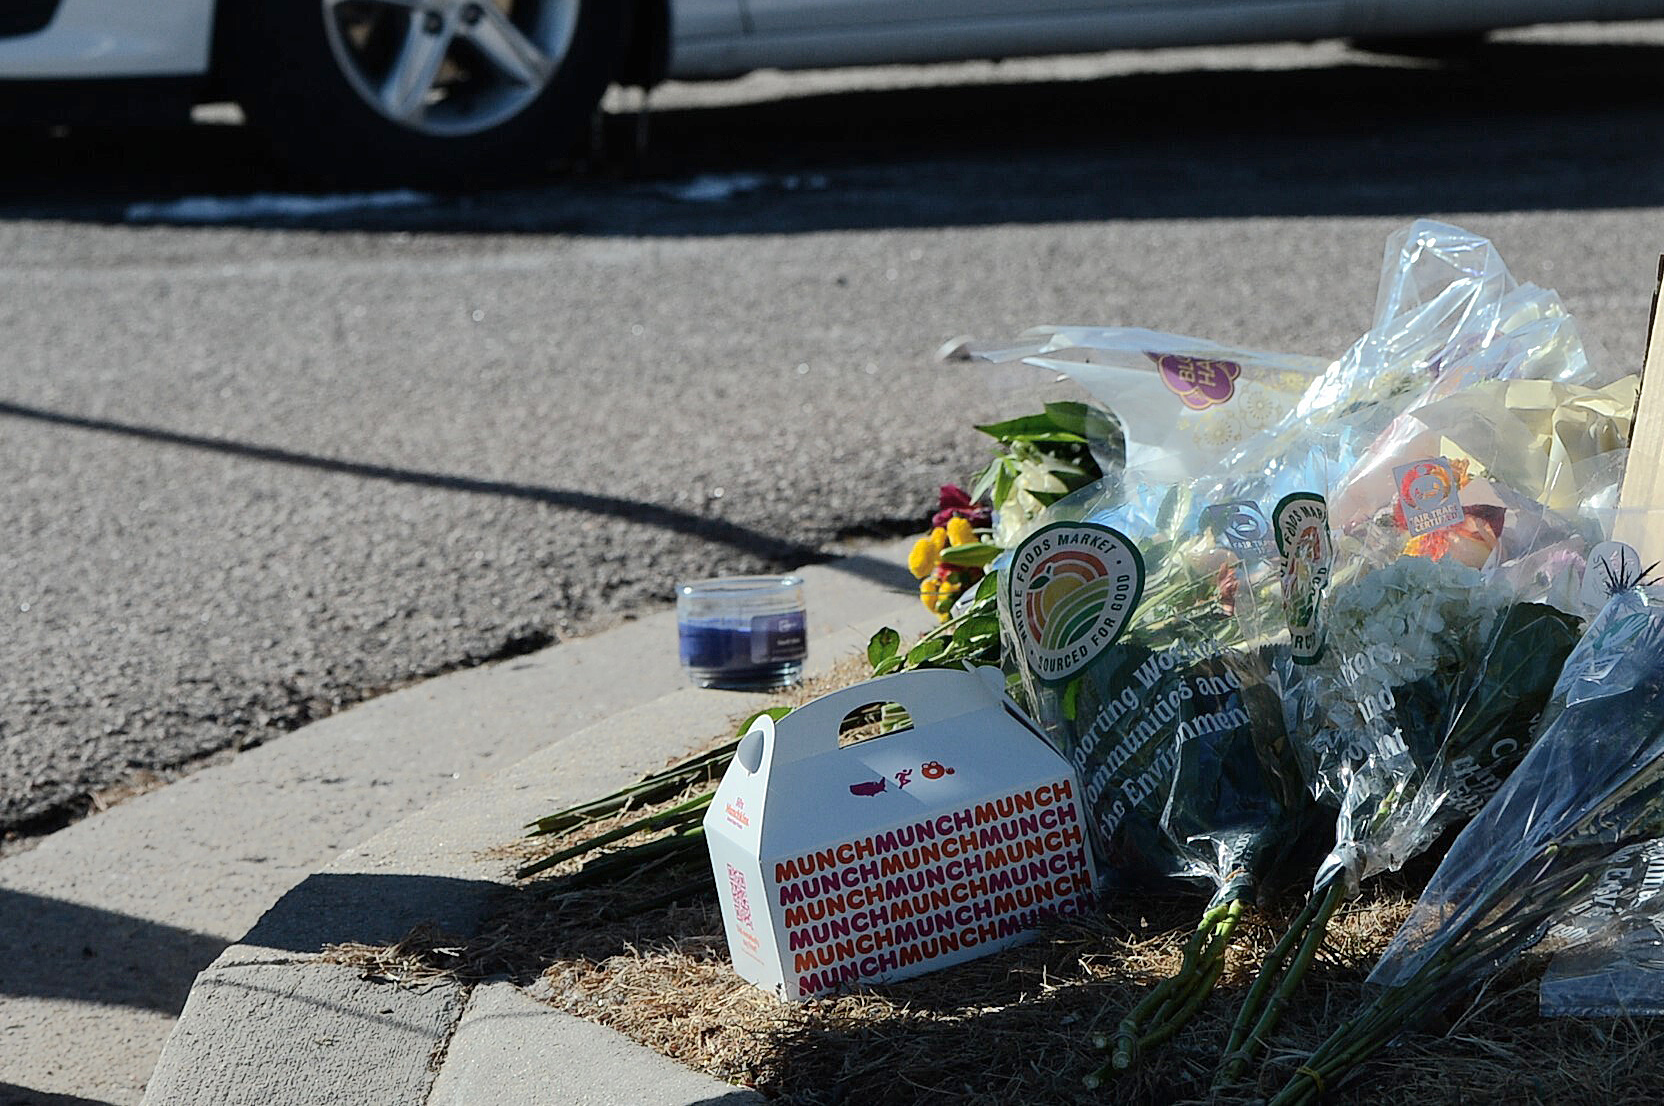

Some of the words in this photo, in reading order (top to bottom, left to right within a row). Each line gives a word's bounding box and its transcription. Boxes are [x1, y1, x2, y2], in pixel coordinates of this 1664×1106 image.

[1017, 539, 1051, 582] FOODS
[1057, 533, 1117, 554] MARKET
[1015, 589, 1028, 644] WHOLE
[1038, 645, 1088, 672] SOURCED
[1090, 617, 1116, 646] FOR
[1111, 574, 1130, 612] GOOD
[1086, 676, 1193, 806] ommunities
[1196, 667, 1242, 695] and
